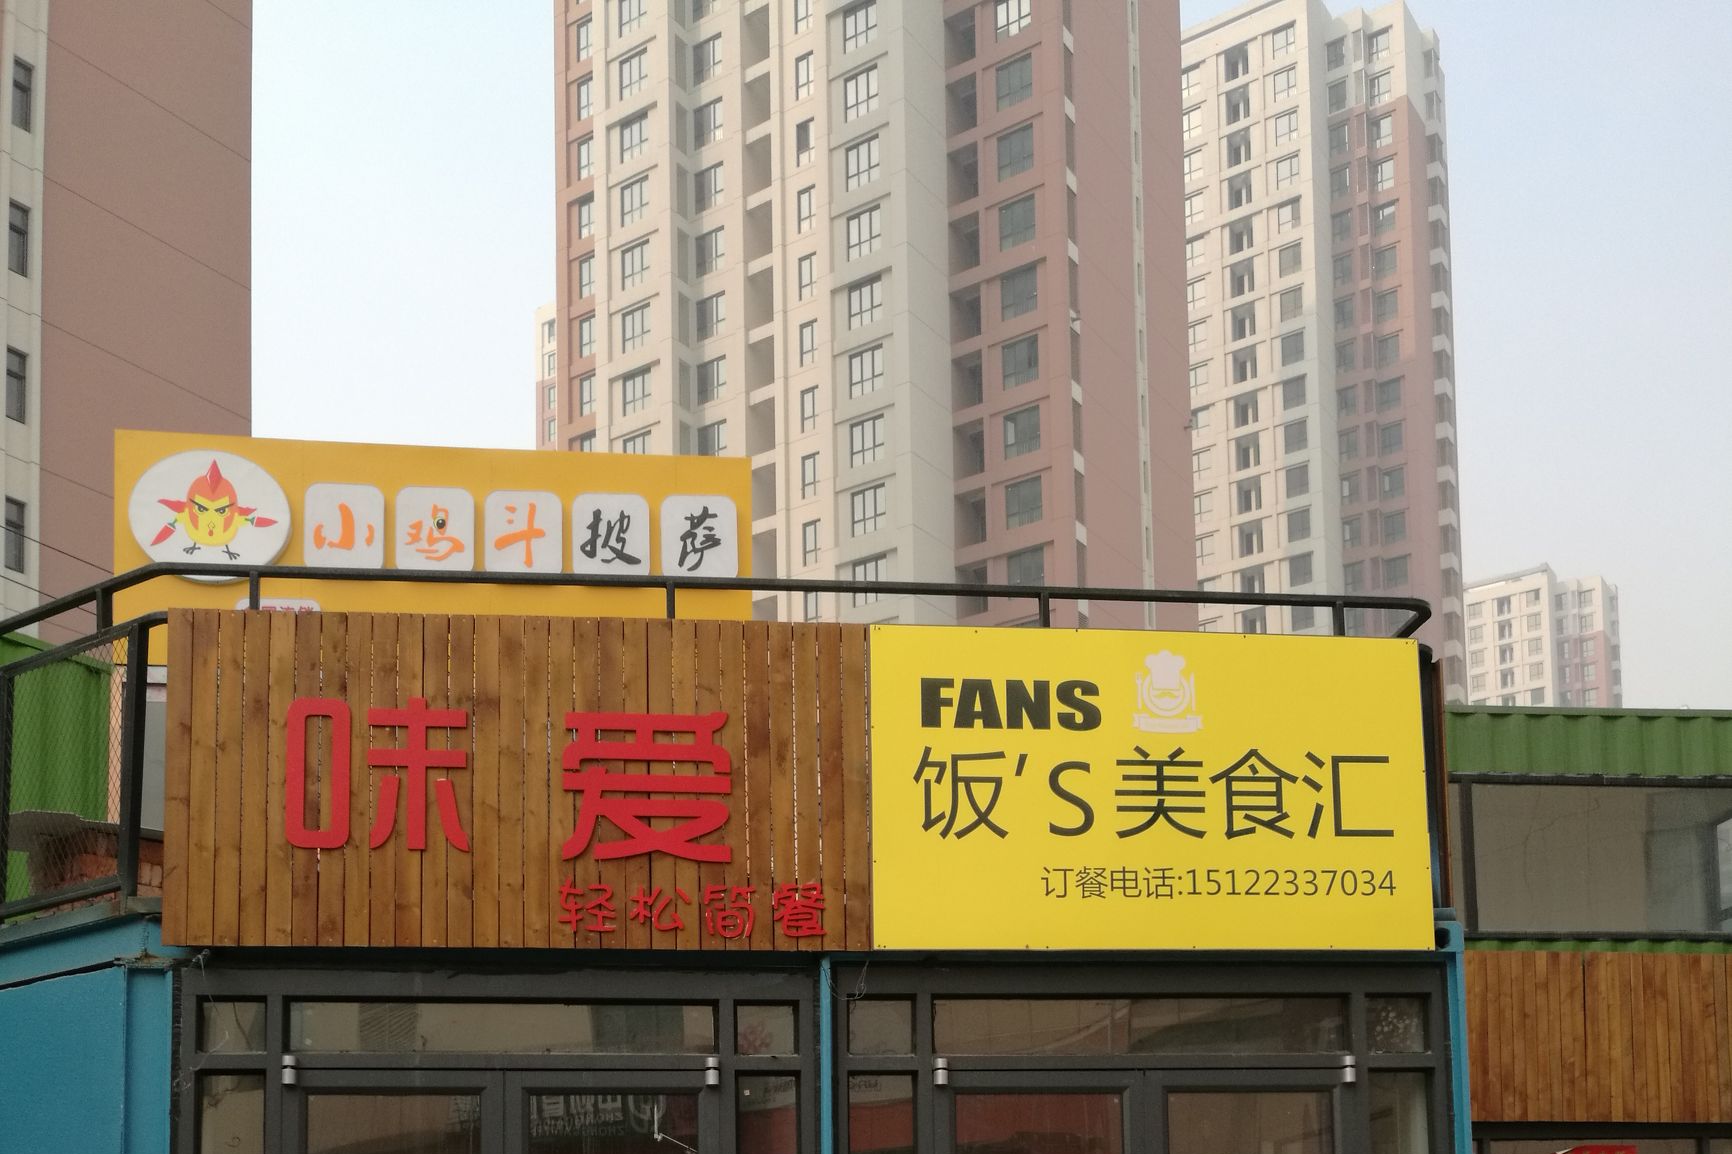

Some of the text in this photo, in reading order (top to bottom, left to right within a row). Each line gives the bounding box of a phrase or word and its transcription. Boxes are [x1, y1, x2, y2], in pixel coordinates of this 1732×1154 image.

[313, 502, 722, 571] 小鸡斗披萨
[920, 677, 1102, 732] FANS
[284, 696, 732, 863] 味爱
[556, 879, 828, 940] 轻松简餐
[1040, 865, 1397, 900] 订餐电话:15122337034
